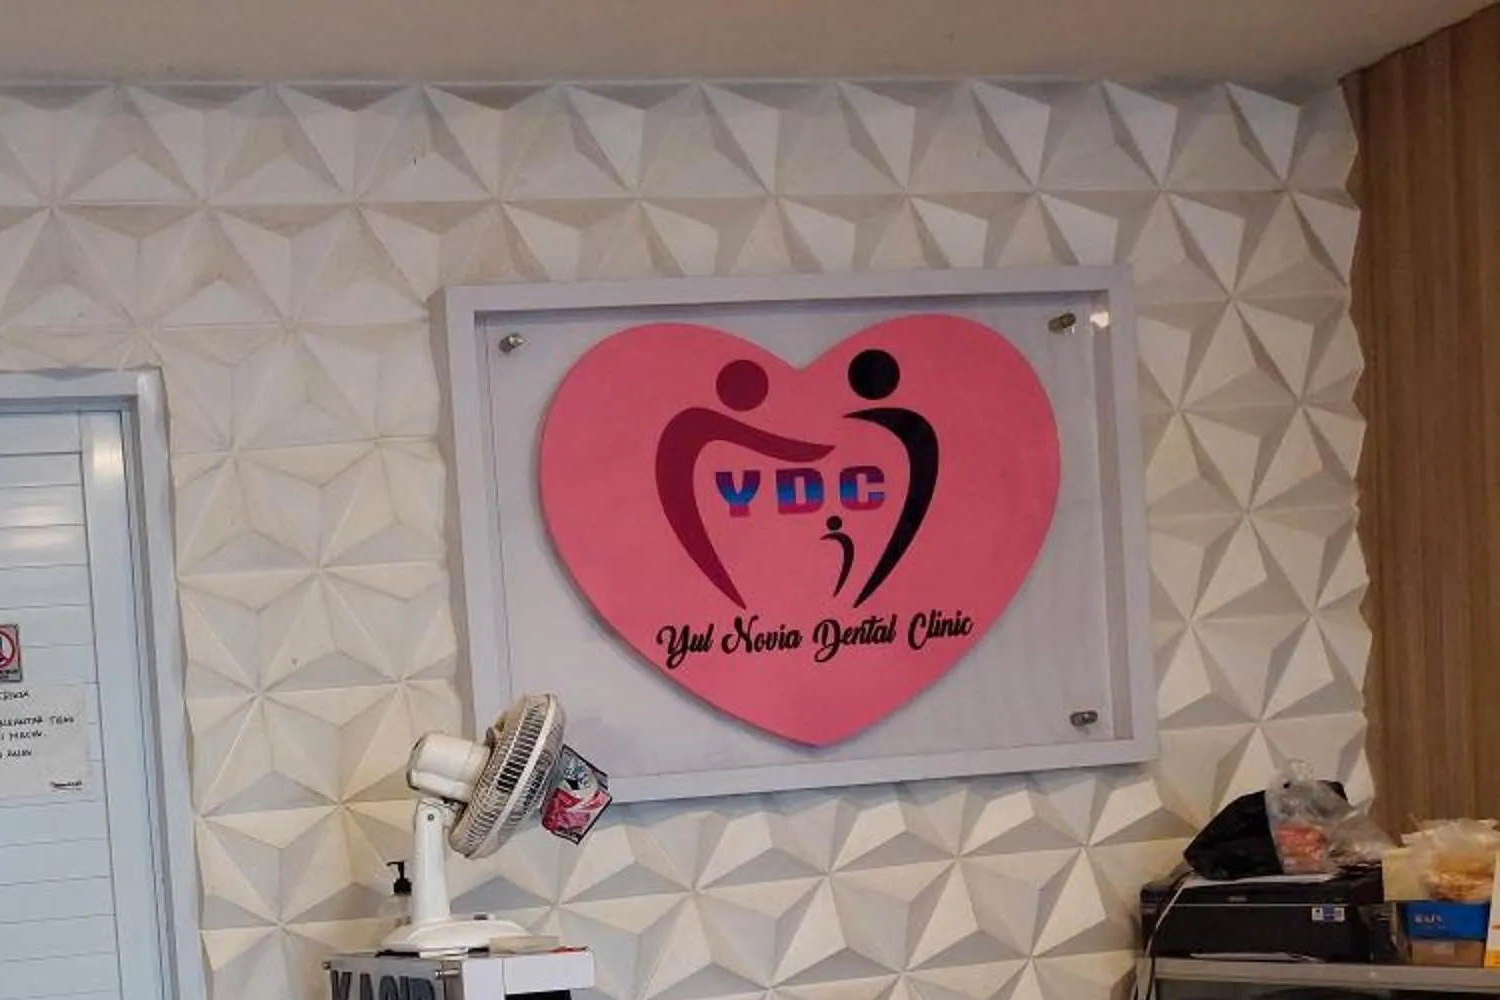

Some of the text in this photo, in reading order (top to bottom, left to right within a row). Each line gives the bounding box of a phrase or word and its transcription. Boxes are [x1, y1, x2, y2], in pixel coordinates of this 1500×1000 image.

[714, 464, 886, 518] YDC
[656, 609, 974, 669] Yul Novia Dental Clinic
